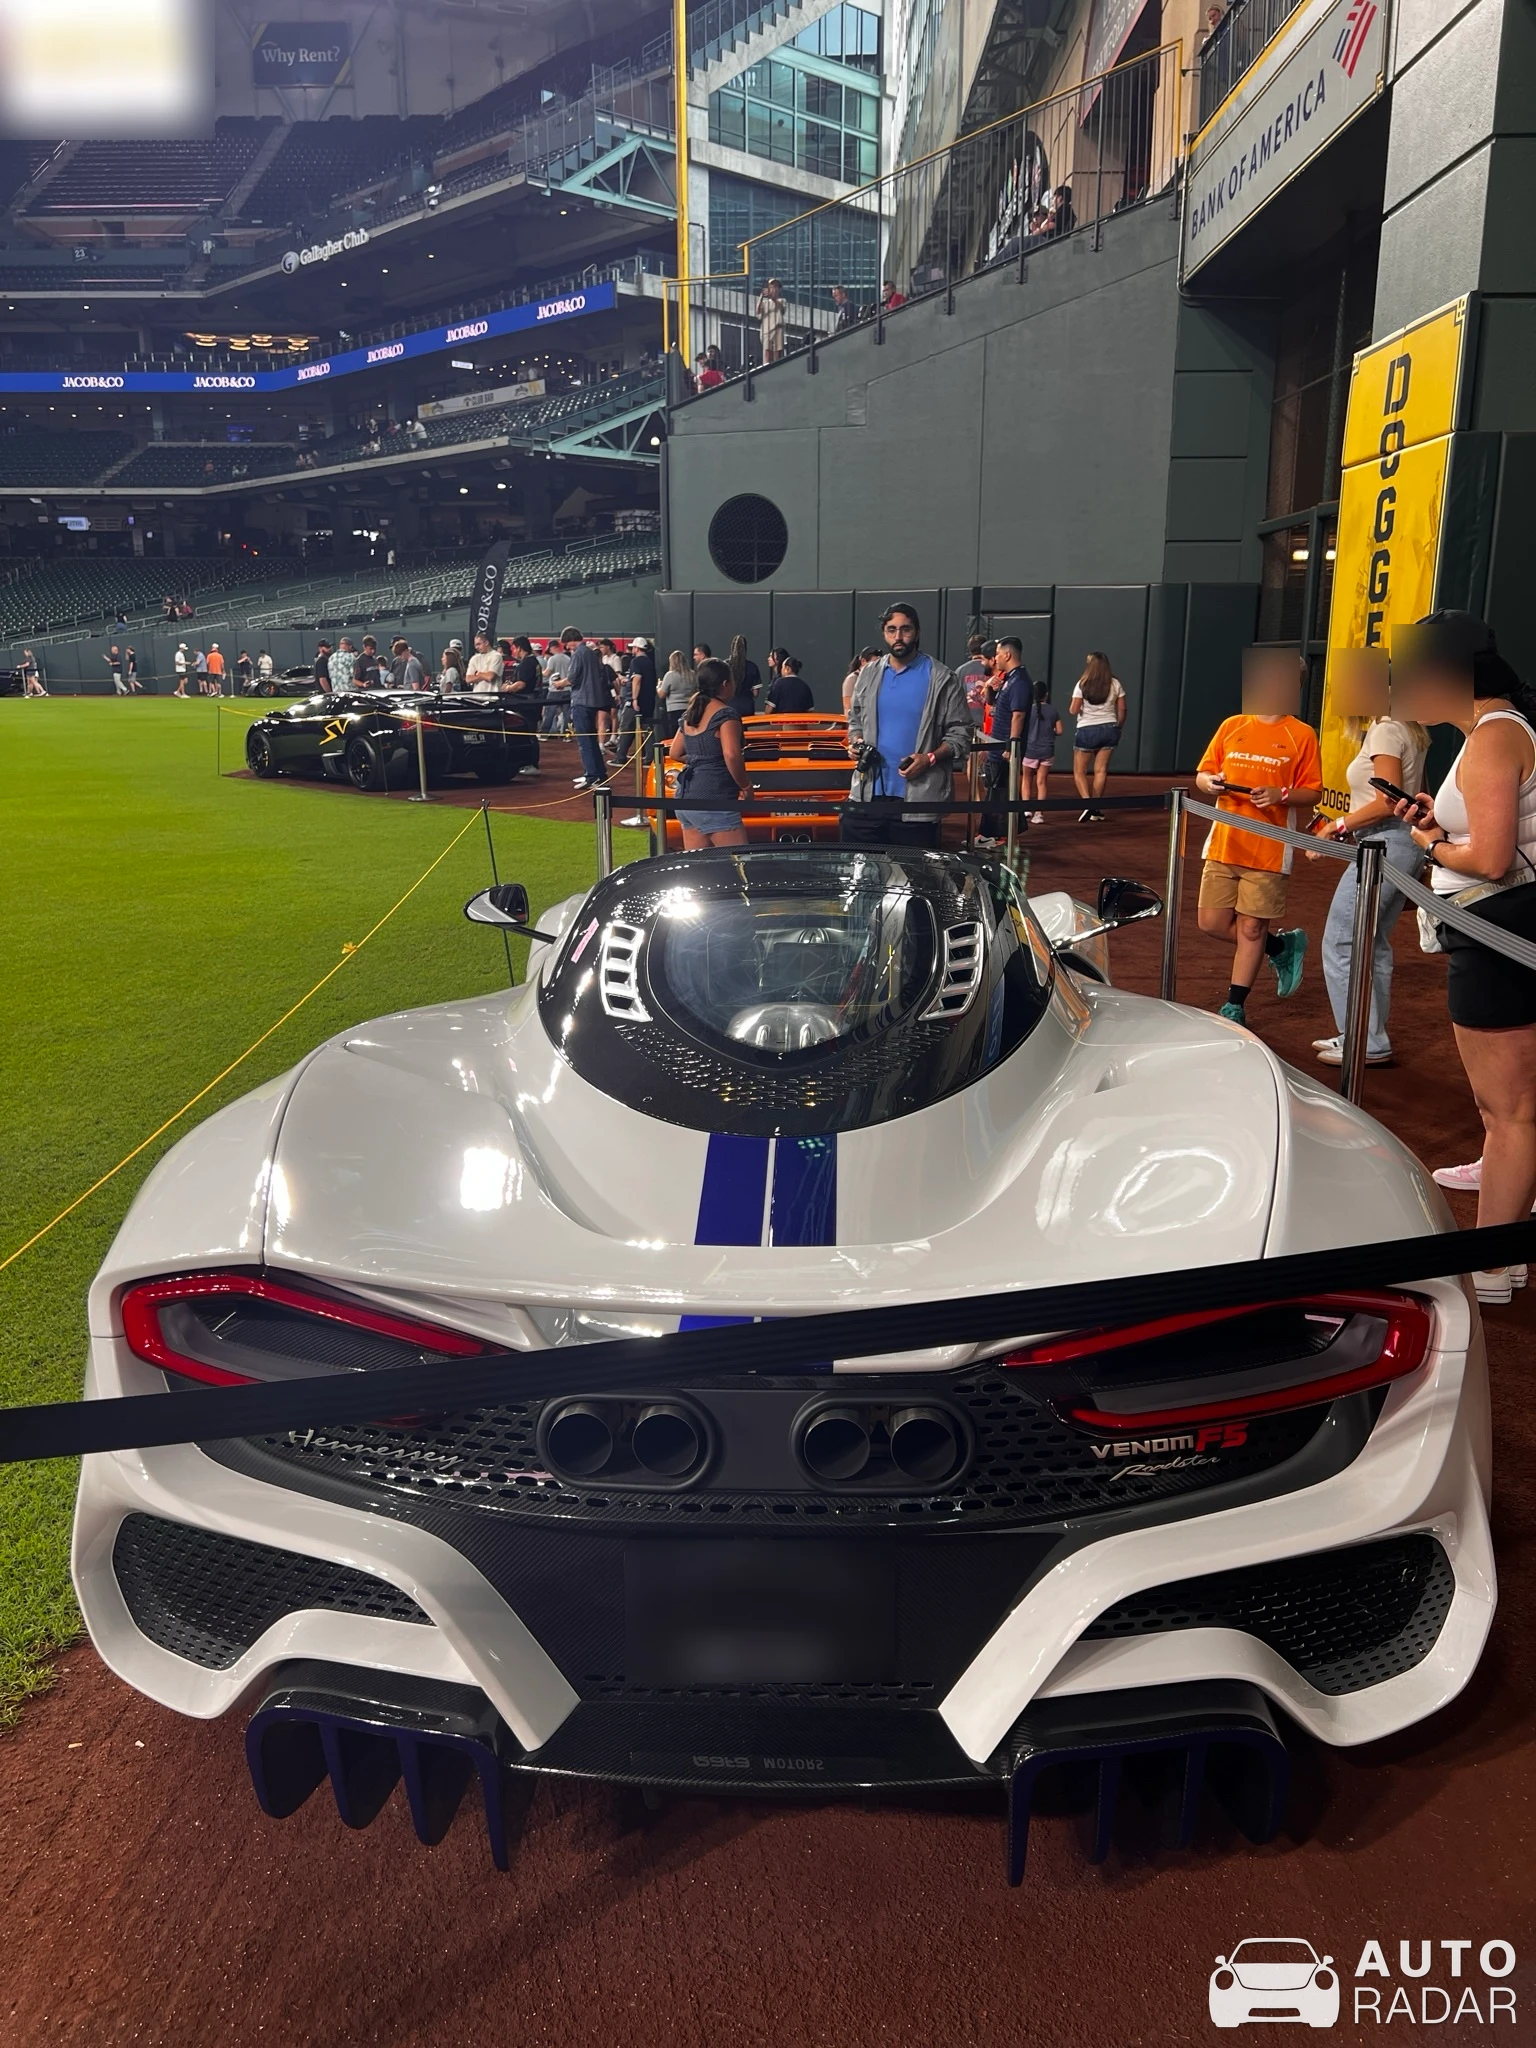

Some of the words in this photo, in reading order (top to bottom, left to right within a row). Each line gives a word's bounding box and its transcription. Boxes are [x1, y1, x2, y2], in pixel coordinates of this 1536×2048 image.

[262, 47, 296, 66] Why
[299, 46, 340, 62] Rent?
[1191, 177, 1225, 240] BANK
[1228, 154, 1247, 200] OF
[1249, 68, 1326, 181] AMERICA
[300, 240, 343, 265] Gallagher
[343, 228, 369, 250] Club
[537, 296, 586, 320] JACOB&CO
[446, 321, 488, 343] JACOB&CO
[367, 343, 404, 363] JACOB&CO
[62, 376, 124, 388] JACOB&CO
[193, 376, 256, 388] JACOB&CO
[297, 363, 330, 380] JACOB&CO
[477, 565, 498, 633] OB&CO
[1226, 751, 1281, 767] McLaren
[289, 1428, 464, 1470] Hennessey
[1090, 1435, 1194, 1459] VENOM
[1195, 1422, 1249, 1452] F5
[1109, 1455, 1221, 1482] Roadster
